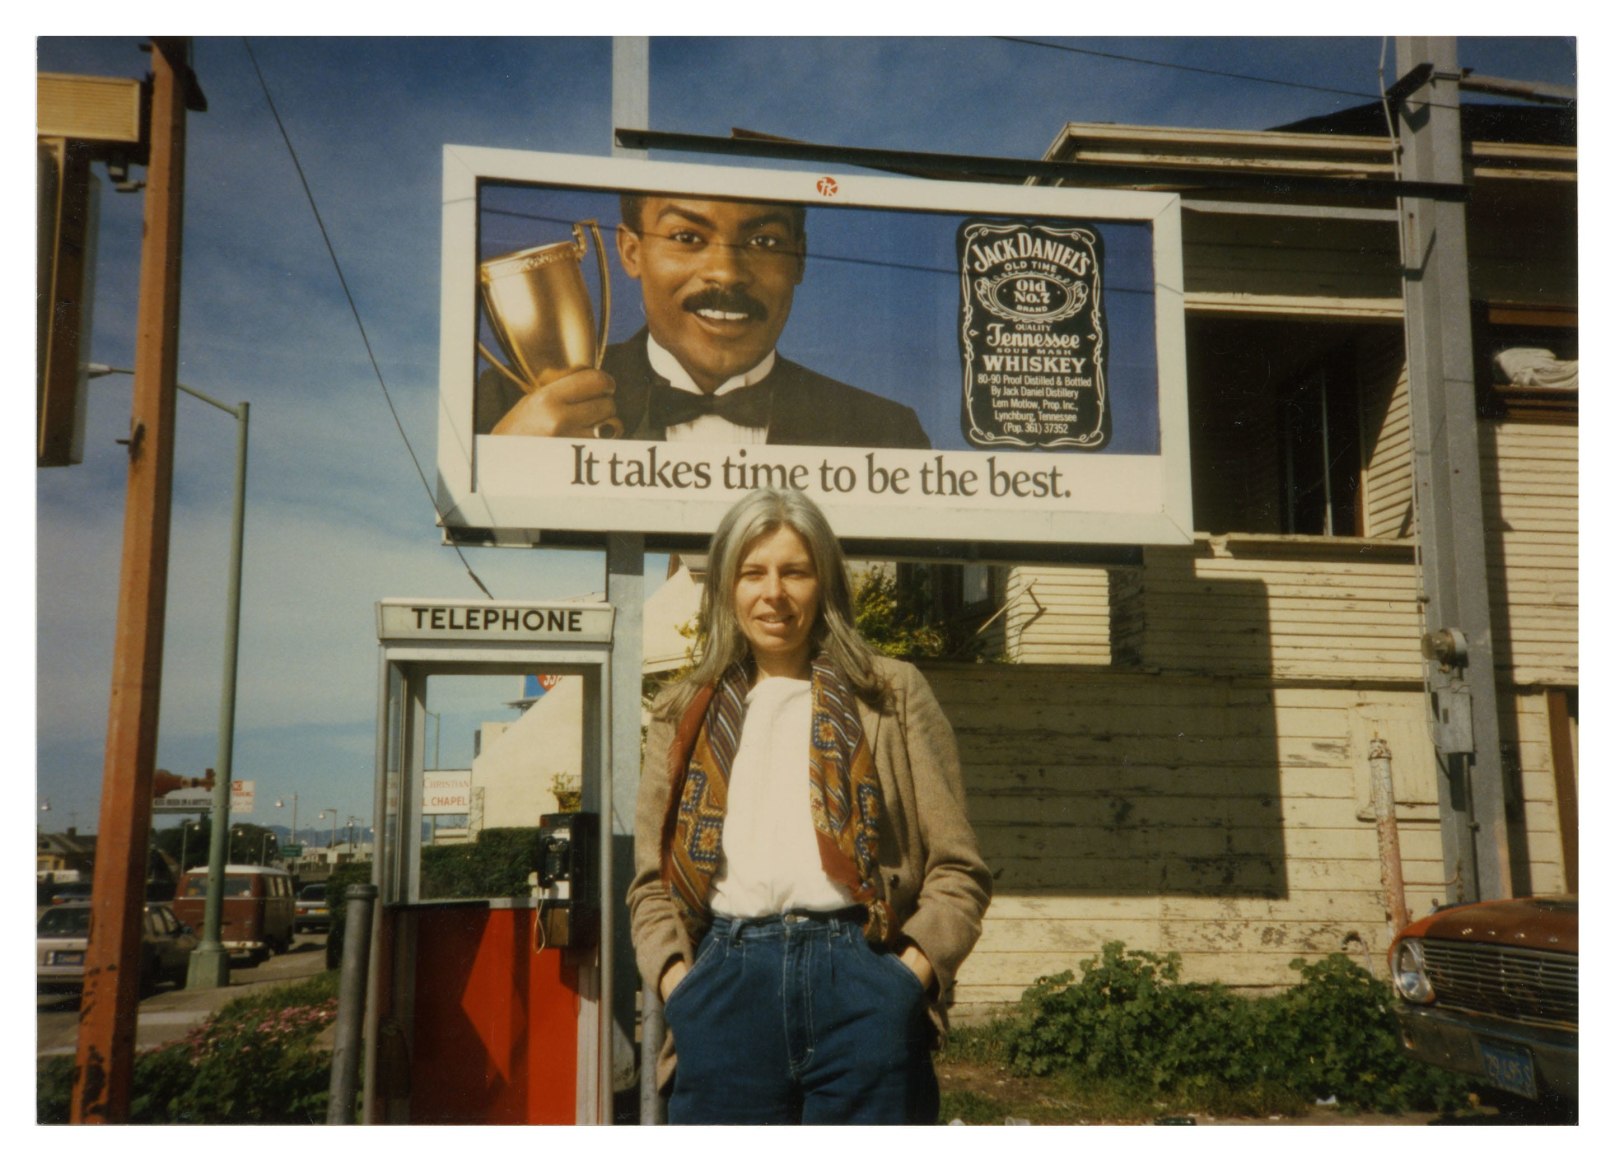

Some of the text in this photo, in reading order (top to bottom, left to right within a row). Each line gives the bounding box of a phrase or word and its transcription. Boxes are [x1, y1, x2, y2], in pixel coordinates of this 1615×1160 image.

[972, 232, 1090, 276] JACK DANIEL'S
[1004, 261, 1058, 273] OLD TIME
[1016, 279, 1047, 292] Old
[1016, 305, 1048, 313] BRAND
[1015, 324, 1051, 332] QUALITY
[986, 323, 1080, 348] Tennessee
[982, 355, 1086, 373] WHISKEY
[977, 374, 1092, 387] 80-90 Proof Distilled & Bottled
[991, 386, 1079, 399] By Jack Daniel Distillery
[992, 398, 1009, 408] Lem
[1042, 400, 1061, 411] Prop.
[994, 411, 1077, 423] Lynchburg, Tennessee
[1003, 422, 1068, 435] (Pop. 361) 37352
[570, 445, 1071, 498] It takes time to be the best.
[411, 608, 582, 632] TELEPHONE
[431, 796, 467, 806] CHAPEL
